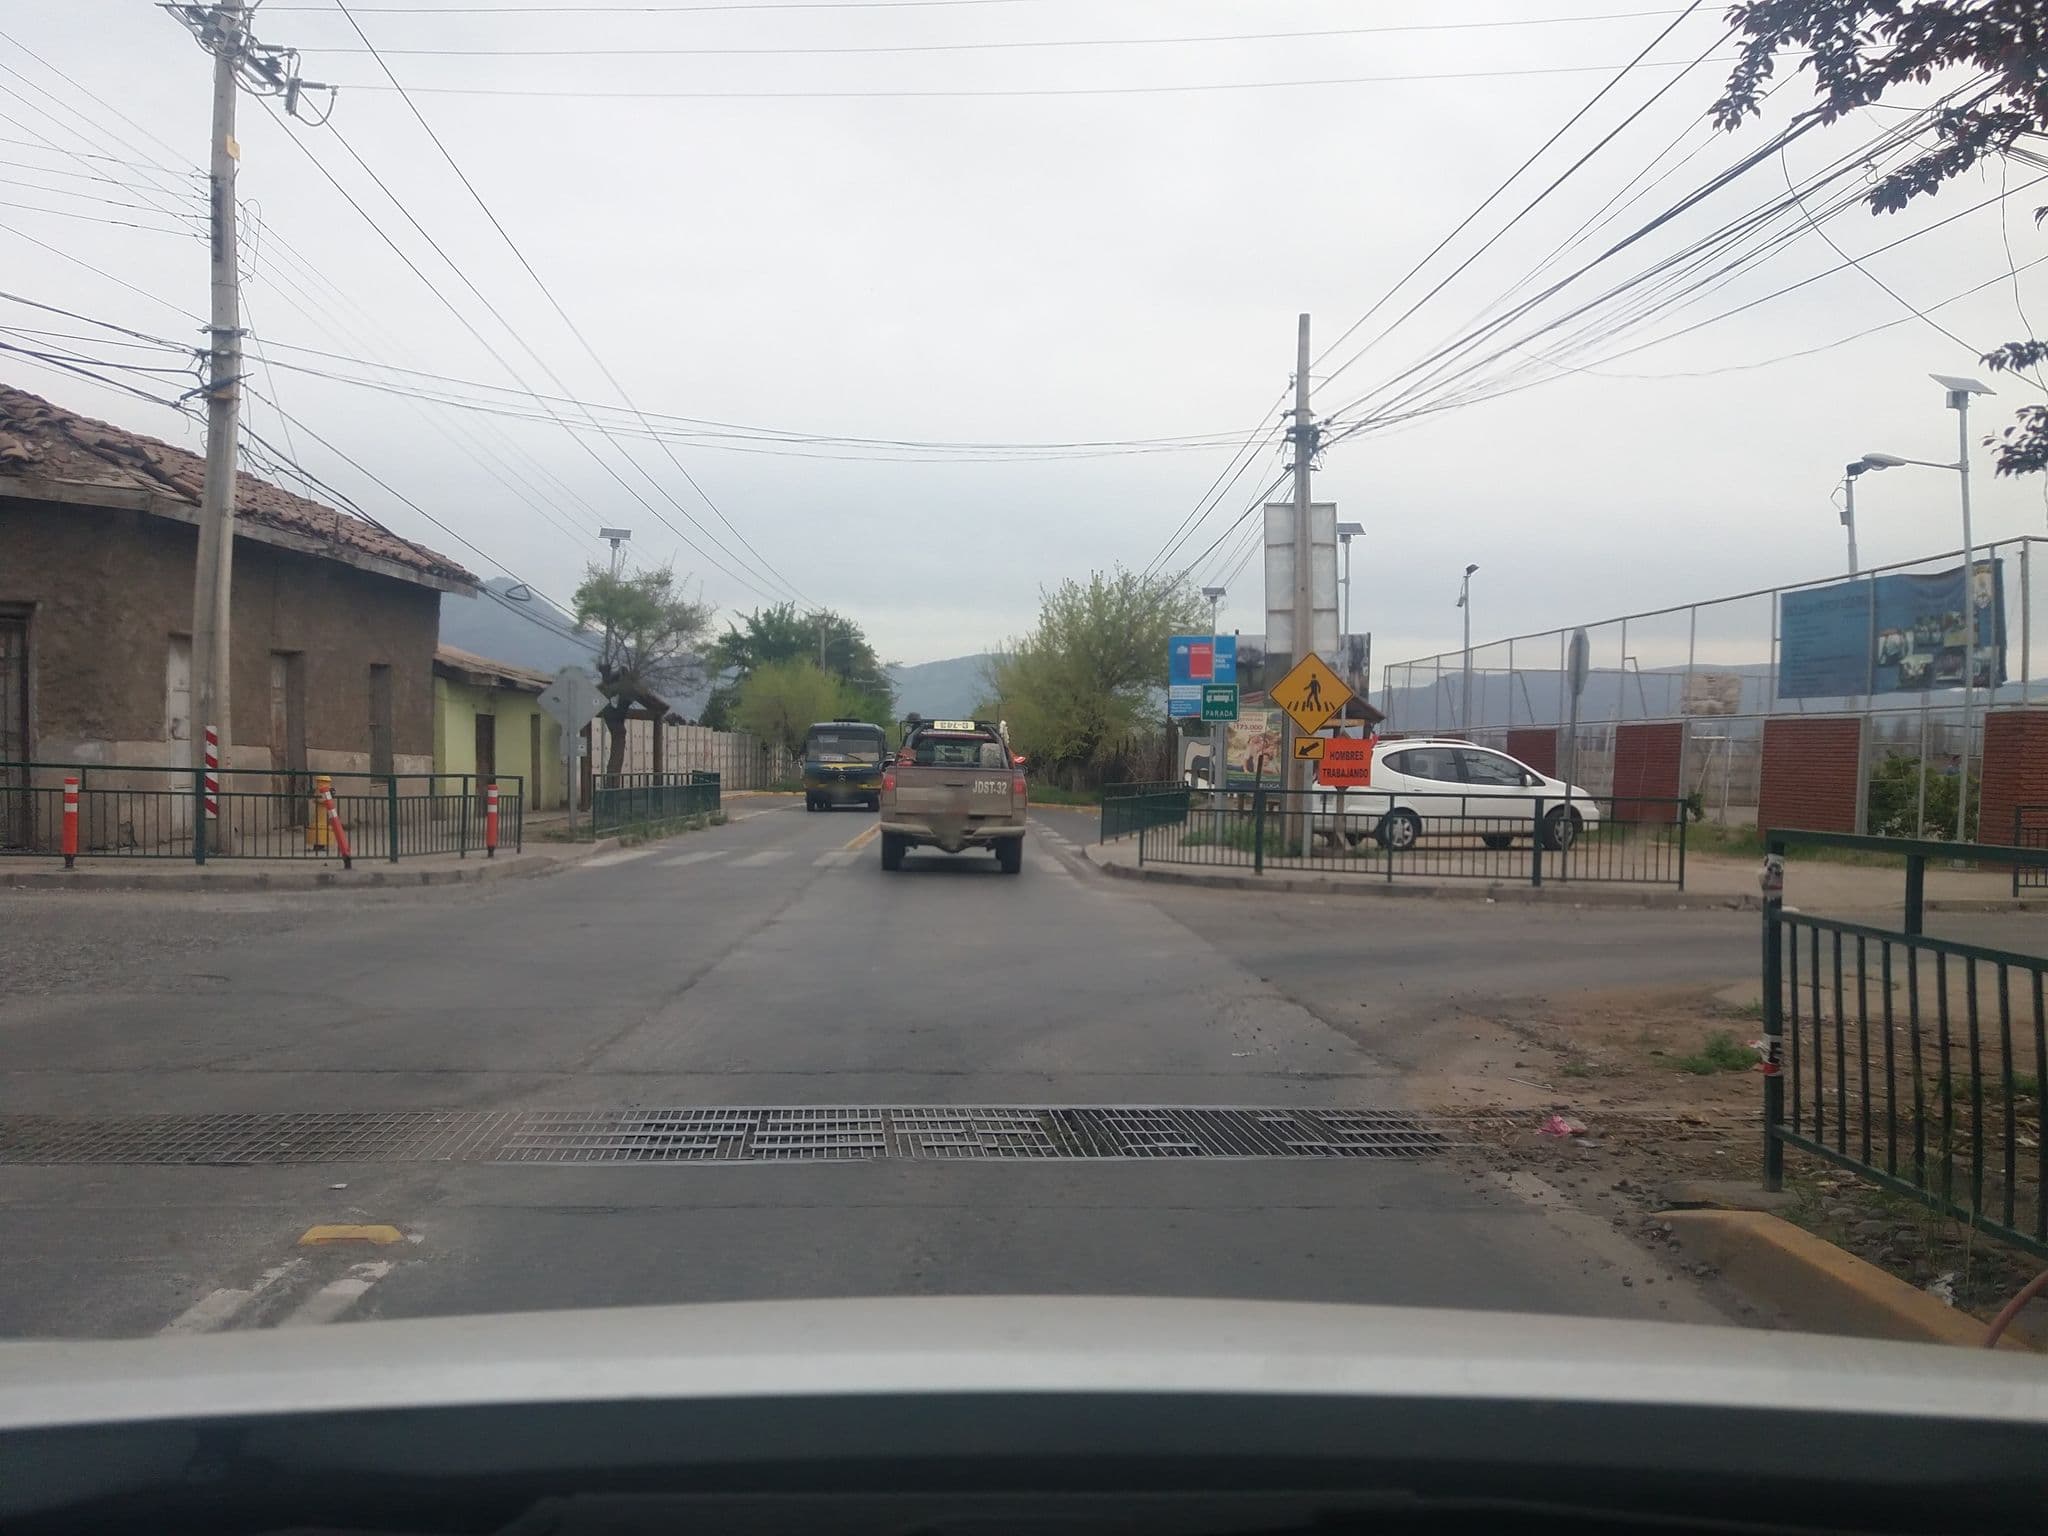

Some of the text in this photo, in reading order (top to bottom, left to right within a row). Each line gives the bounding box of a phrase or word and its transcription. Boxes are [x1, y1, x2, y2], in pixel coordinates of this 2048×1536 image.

[1205, 710, 1233, 718] PARADA
[1329, 750, 1364, 760] HOMBRES
[1322, 768, 1369, 778] TRABAJANDO
